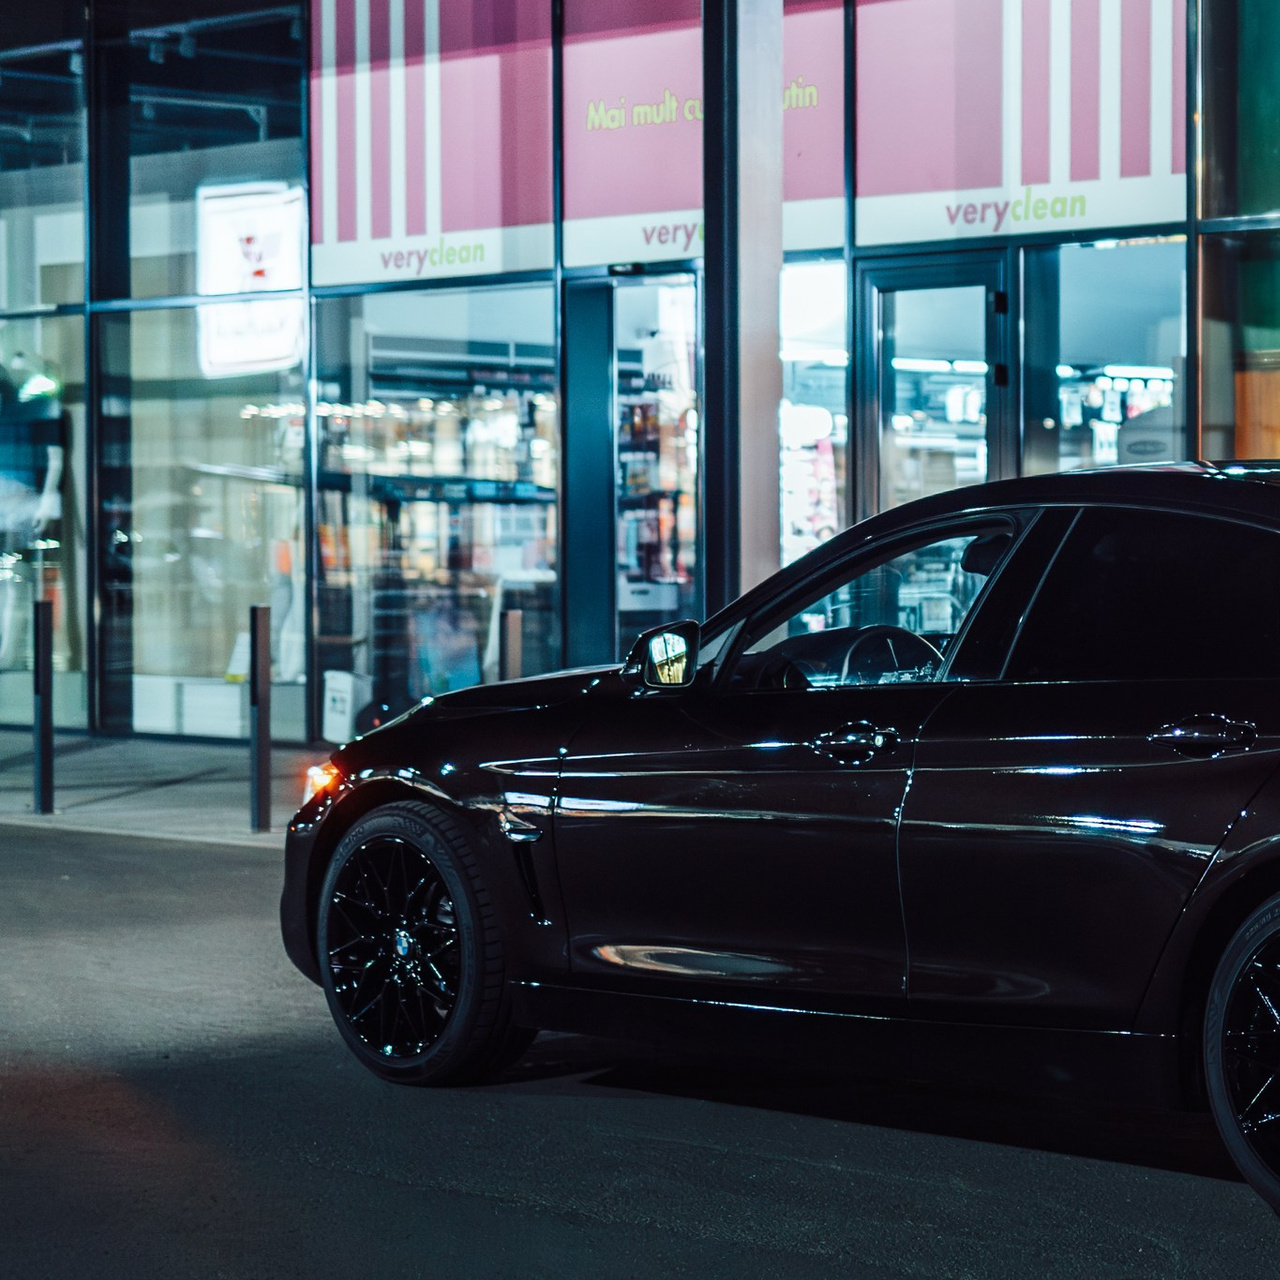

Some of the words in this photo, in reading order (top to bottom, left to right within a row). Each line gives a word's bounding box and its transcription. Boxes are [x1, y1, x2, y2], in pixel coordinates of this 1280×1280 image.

[586, 97, 626, 132] Mai
[632, 89, 678, 125] mult
[642, 222, 704, 252] very
